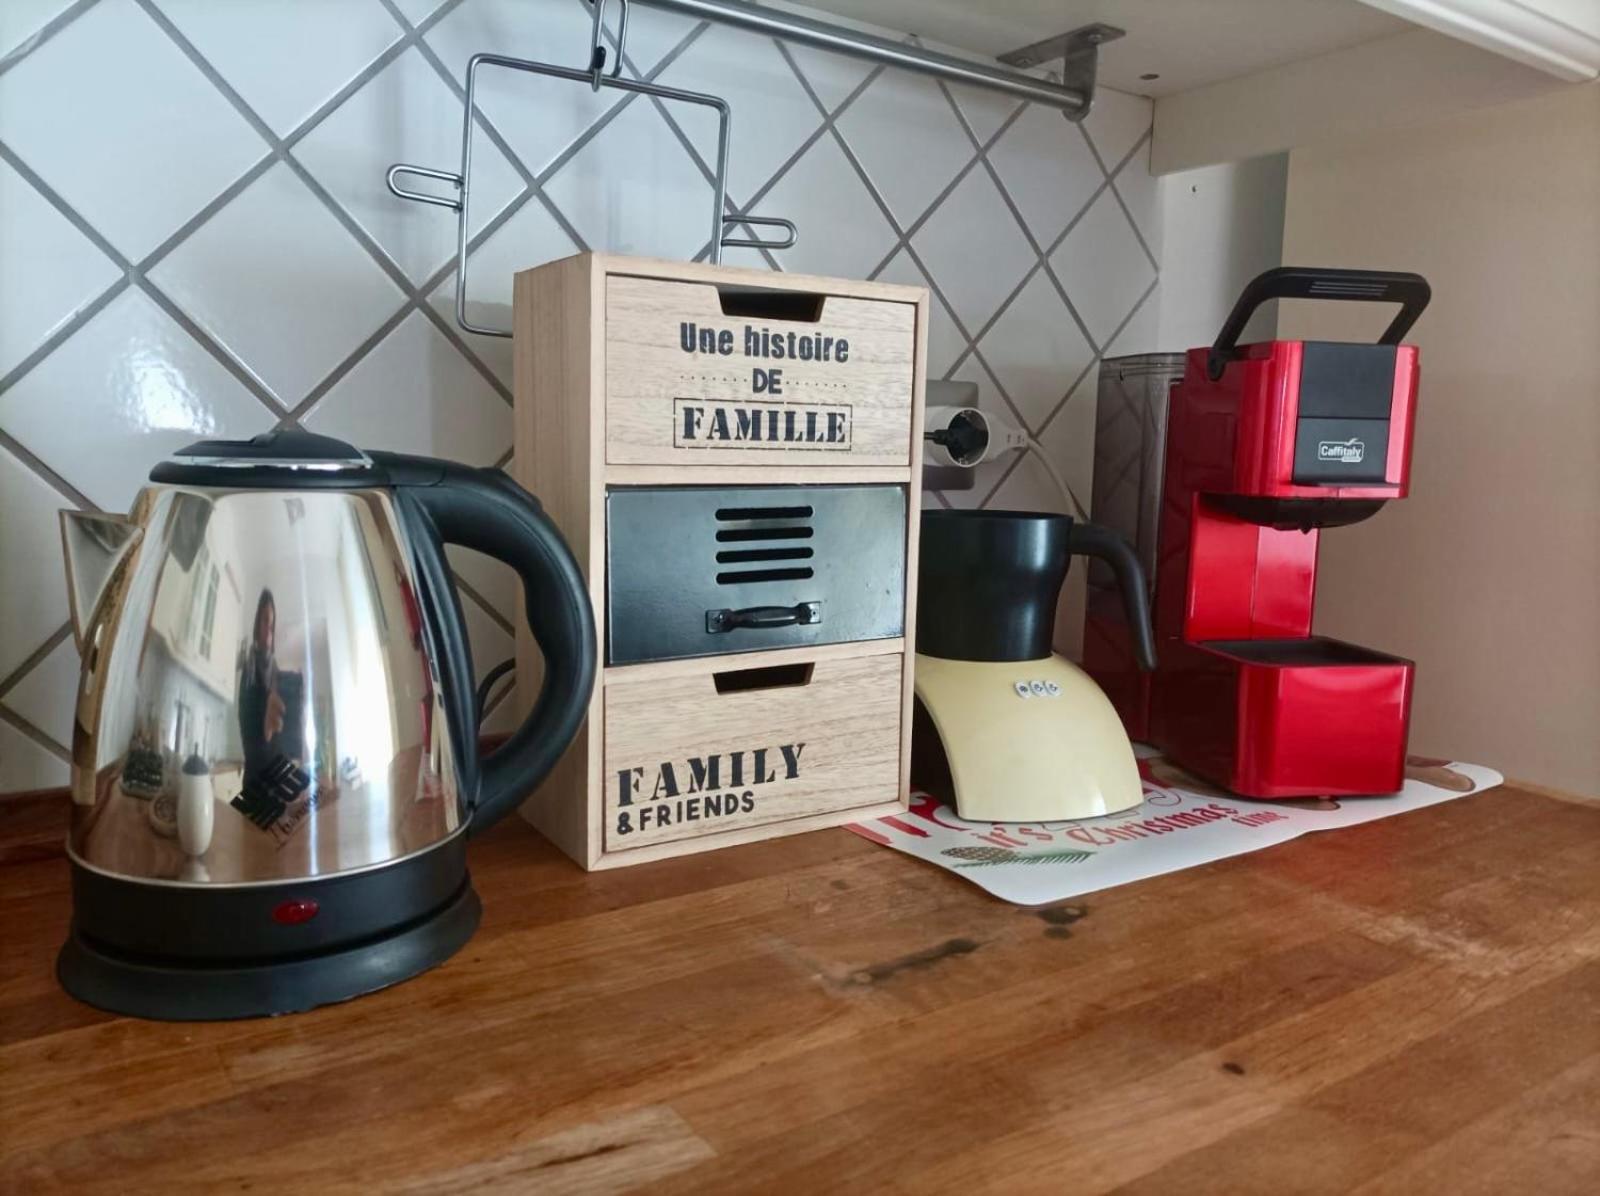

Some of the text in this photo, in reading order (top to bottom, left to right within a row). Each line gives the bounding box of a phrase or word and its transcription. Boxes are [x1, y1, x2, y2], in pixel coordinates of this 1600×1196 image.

[680, 322, 849, 363] Une histoire
[752, 368, 783, 394] DE
[682, 406, 846, 443] FAMILLE
[1321, 446, 1361, 458] Caffitaly
[617, 743, 806, 807] FAMILY
[1066, 803, 1239, 846] Christmas
